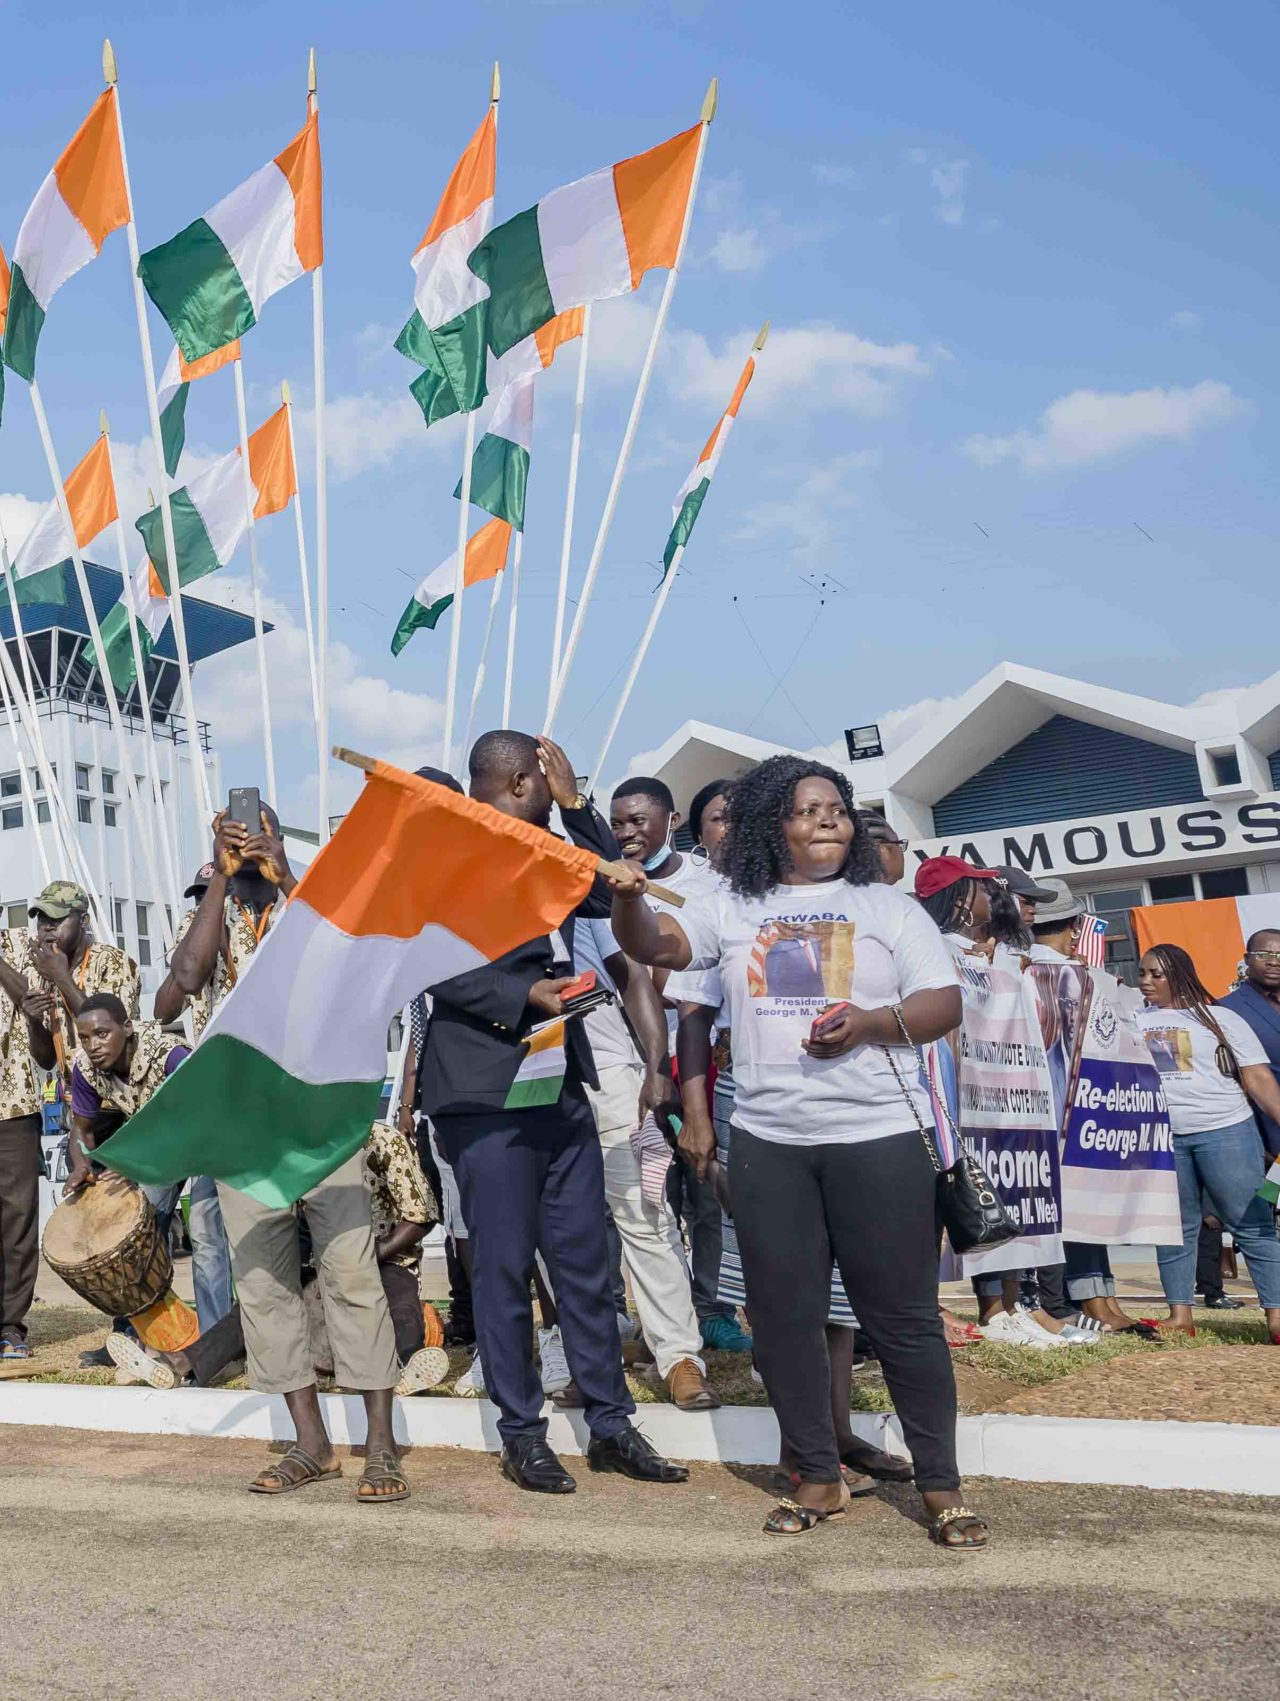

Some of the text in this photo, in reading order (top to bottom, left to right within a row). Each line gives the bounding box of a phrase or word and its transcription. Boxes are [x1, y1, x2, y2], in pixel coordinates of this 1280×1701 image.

[755, 1008, 797, 1017] George
[800, 1008, 814, 1016] M.
[775, 998, 829, 1006] President
[1074, 1078, 1154, 1113] Re-election
[1080, 1119, 1138, 1159] George
[1138, 1123, 1151, 1152] M.
[1021, 1198, 1035, 1225] M.
